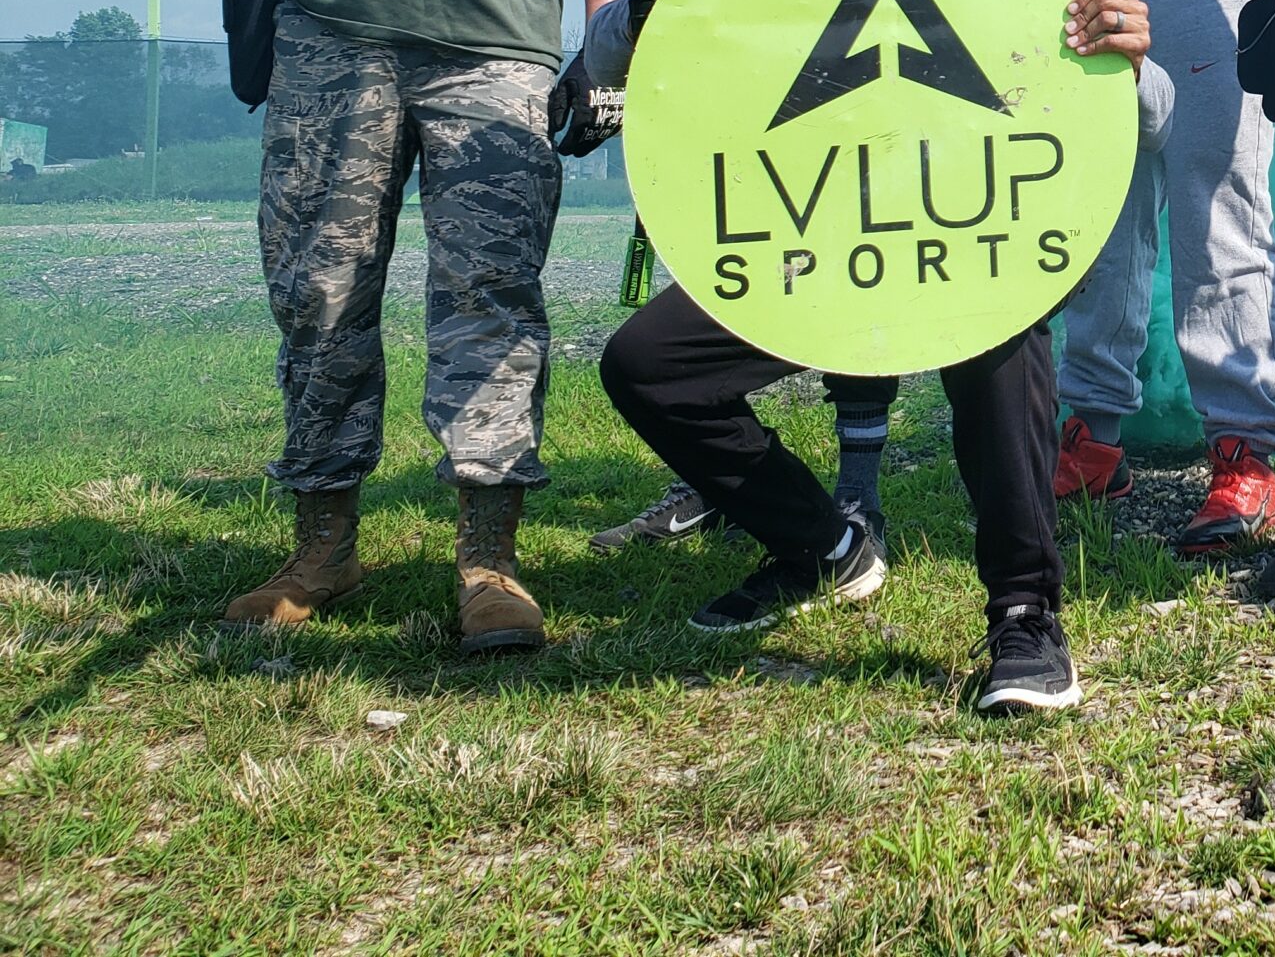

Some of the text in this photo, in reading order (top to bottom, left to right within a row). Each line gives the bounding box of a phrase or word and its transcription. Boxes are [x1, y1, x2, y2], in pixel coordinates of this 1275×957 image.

[713, 132, 1064, 245] LVLUP
[628, 272, 639, 300] RENTAL
[714, 230, 1070, 300] SPORTS
[1006, 604, 1026, 617] NIKE
